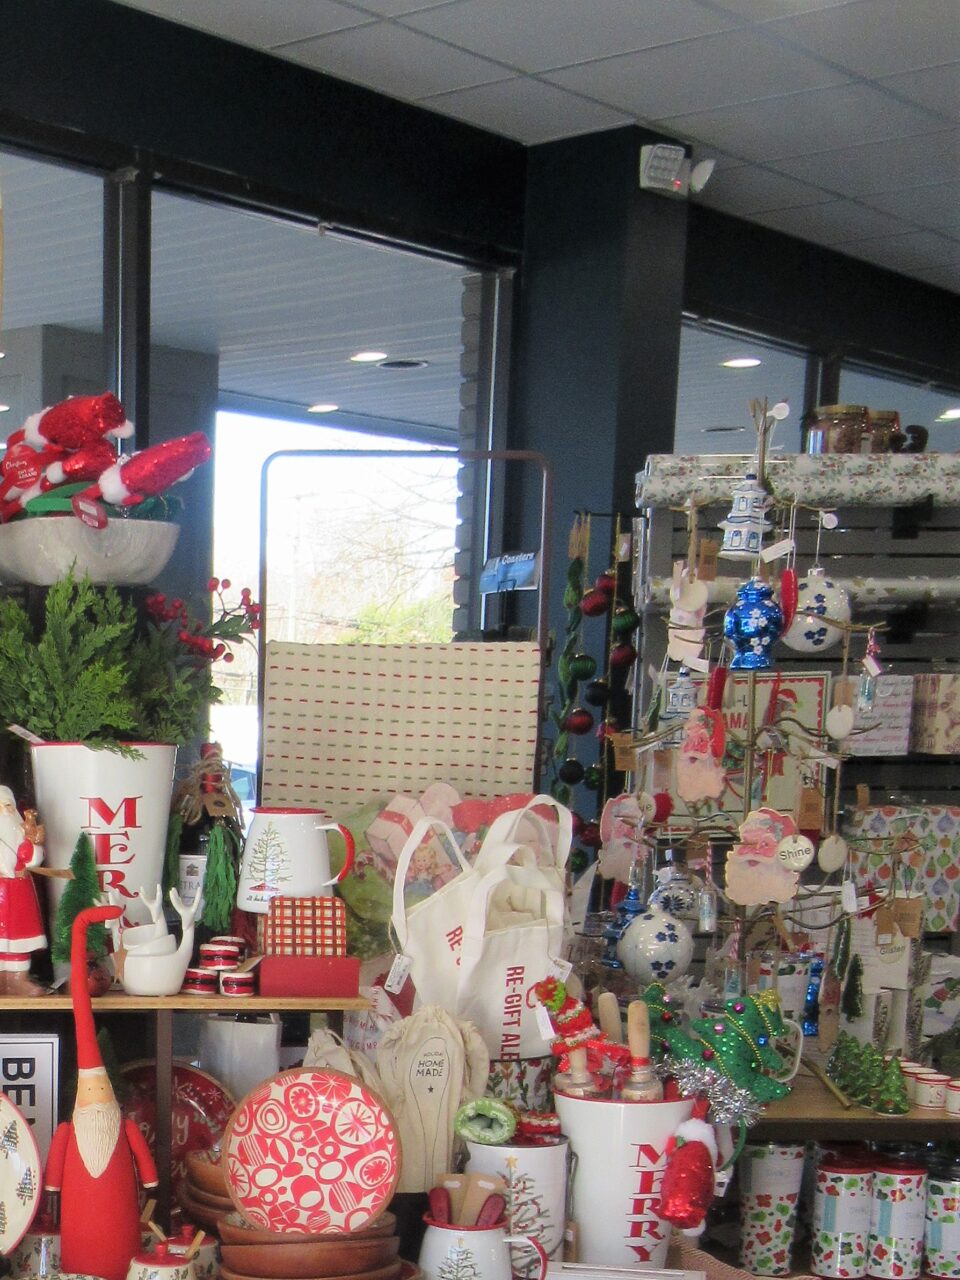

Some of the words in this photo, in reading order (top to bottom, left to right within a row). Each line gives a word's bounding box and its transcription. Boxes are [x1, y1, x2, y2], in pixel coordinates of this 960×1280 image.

[779, 846, 812, 861] Shine
[502, 965, 525, 1027] RE-GIFT
[417, 1060, 445, 1068] HOME
[416, 1068, 443, 1077] MADE
[2, 1057, 36, 1126] BE
